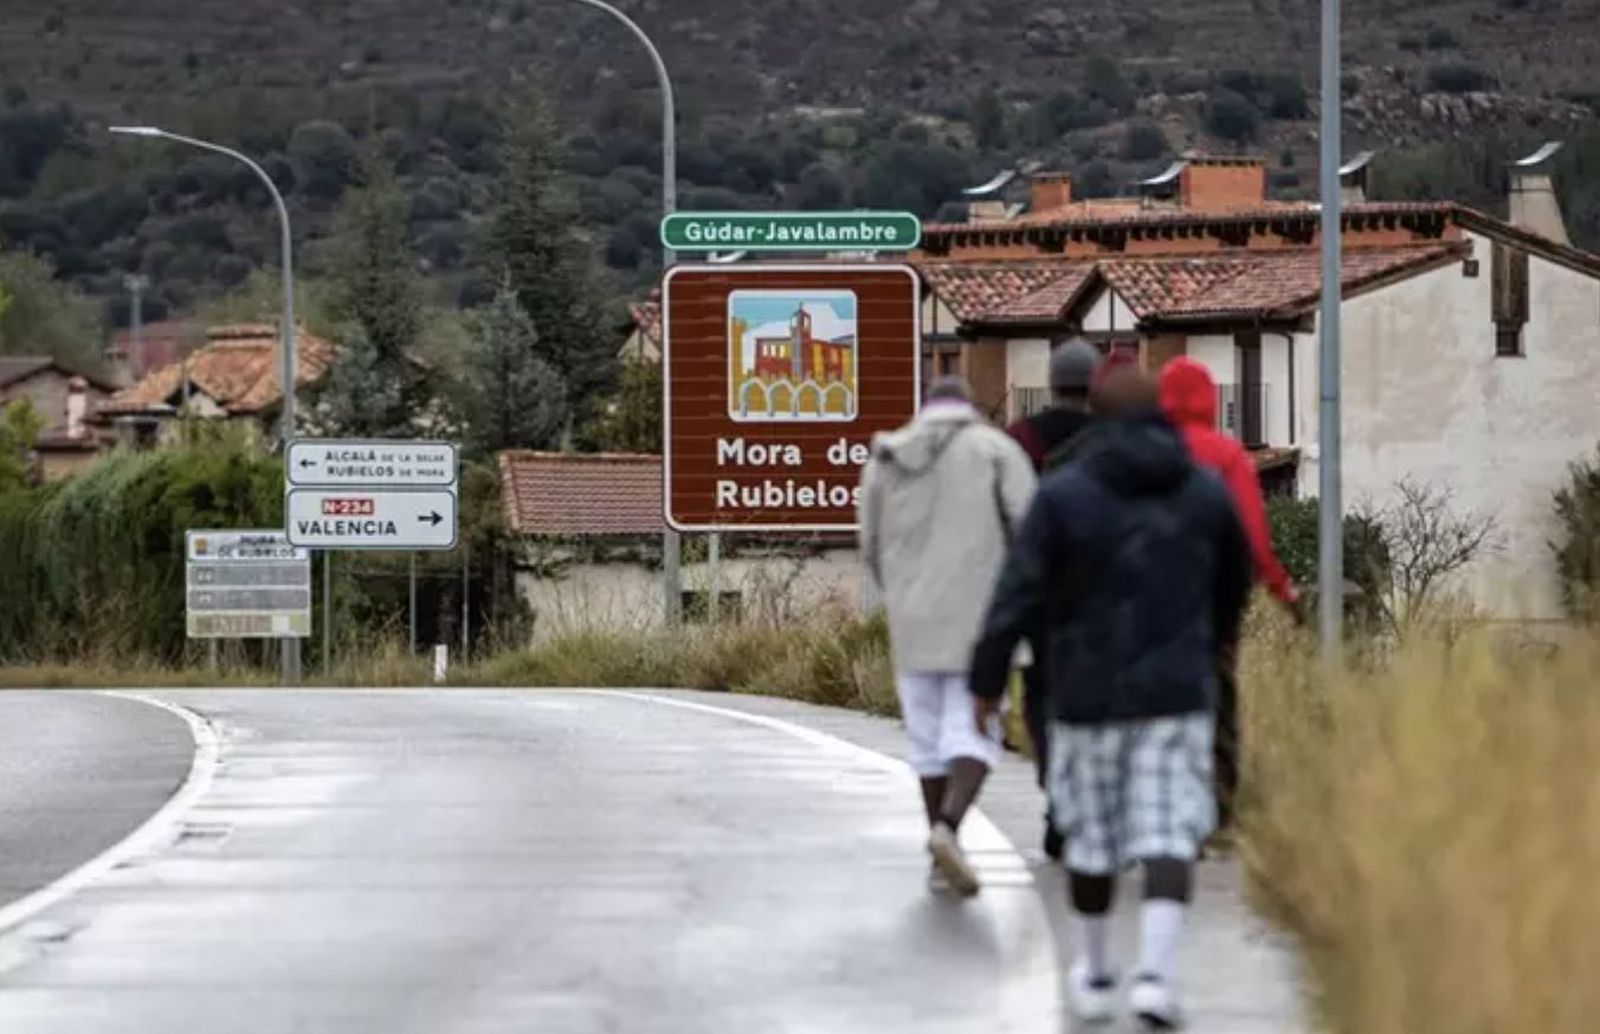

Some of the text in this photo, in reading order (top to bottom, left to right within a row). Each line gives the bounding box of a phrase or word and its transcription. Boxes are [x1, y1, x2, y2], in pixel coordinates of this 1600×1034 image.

[684, 221, 897, 240] Gúdar-Javalambre
[325, 451, 376, 462] ALCALÁ
[717, 438, 869, 466] Mora de
[327, 466, 394, 477] RUBIELOS
[416, 469, 445, 477] MORA
[324, 500, 371, 513] N-234
[297, 520, 397, 536] VALENCIA
